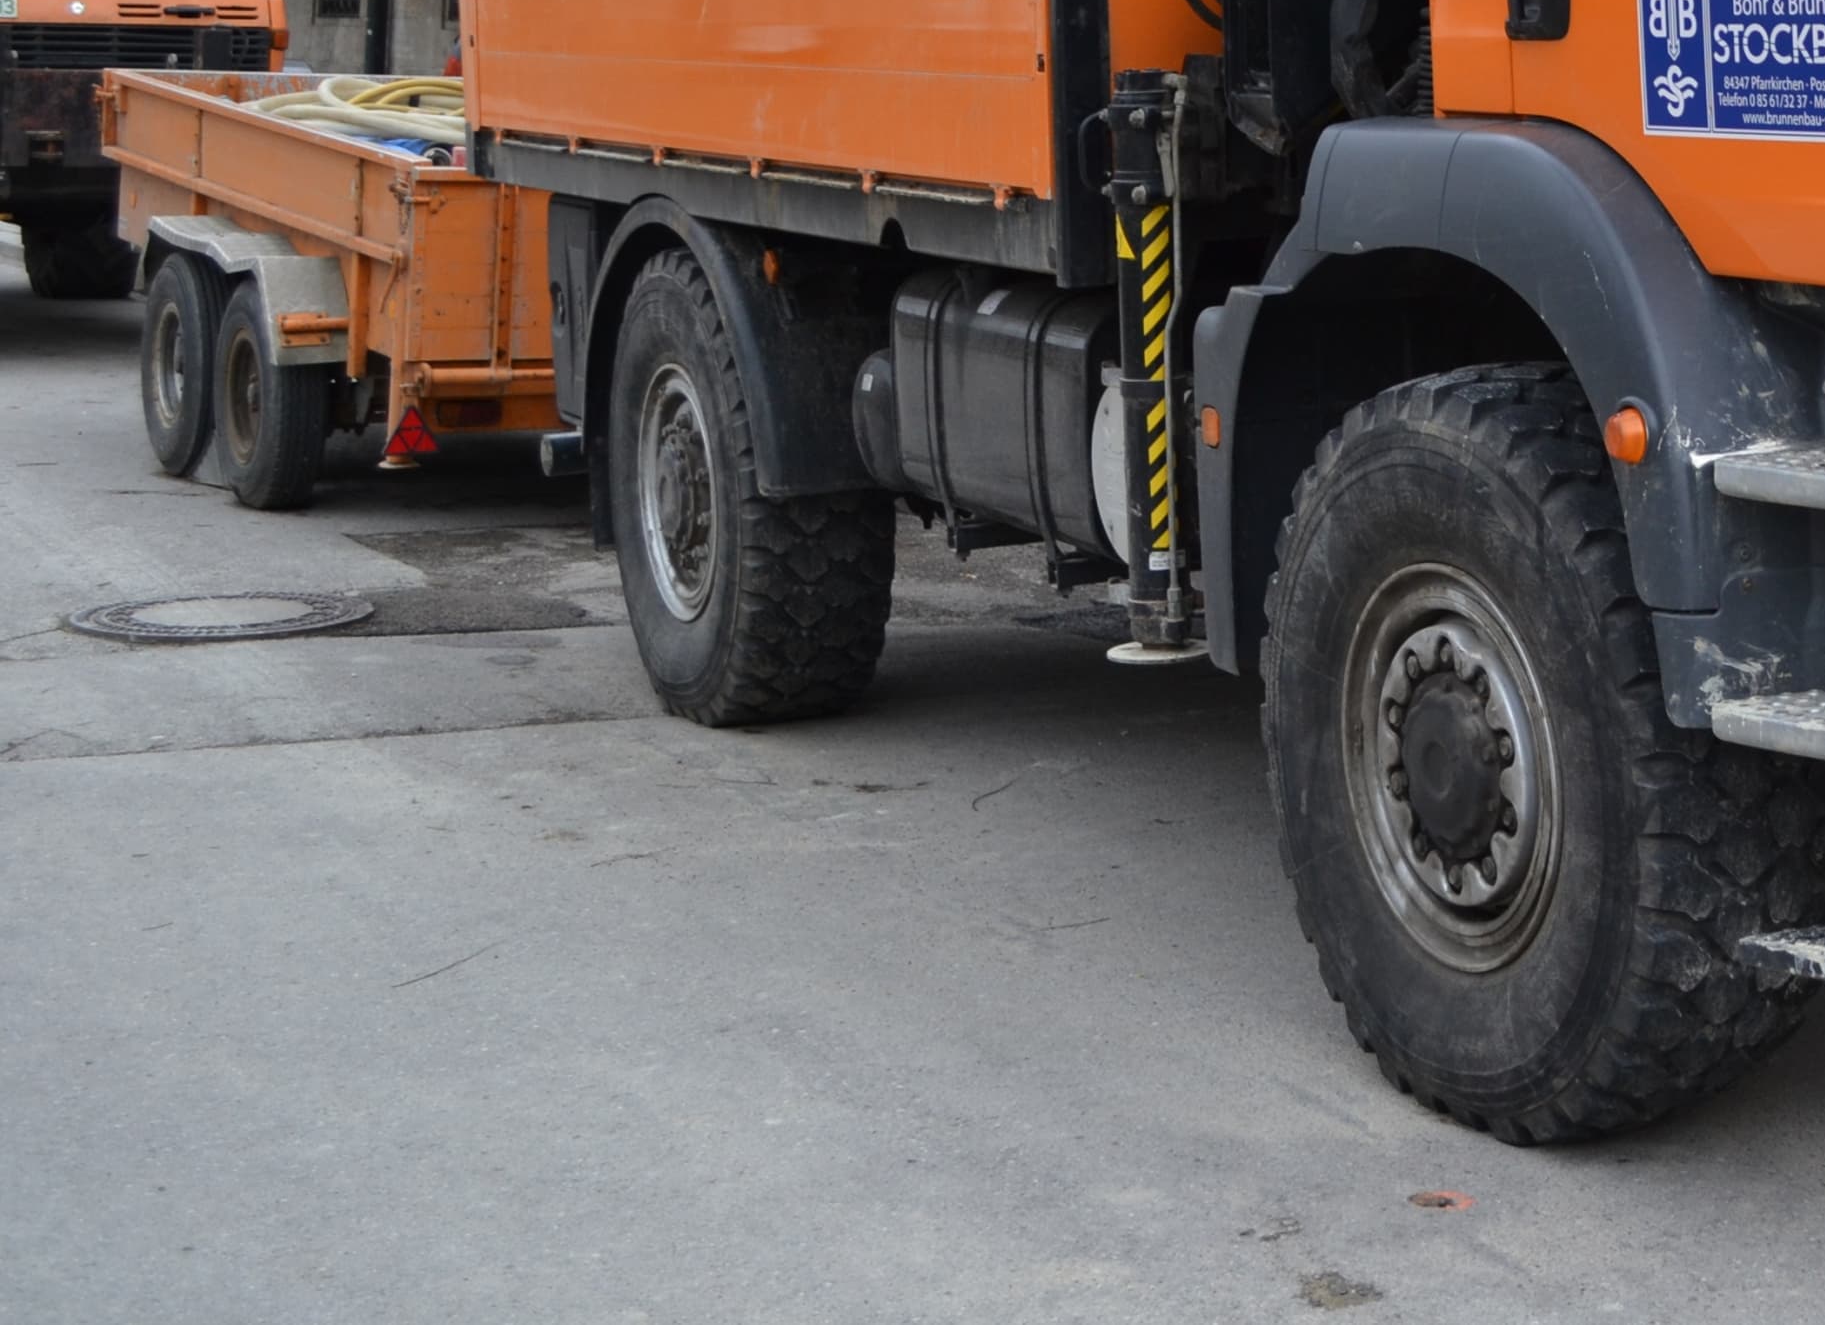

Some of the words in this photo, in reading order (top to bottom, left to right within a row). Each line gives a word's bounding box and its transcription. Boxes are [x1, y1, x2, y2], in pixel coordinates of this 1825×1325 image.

[1723, 76, 1749, 90] 84347
[1751, 76, 1804, 92] Pfarrkirchen
[1717, 92, 1748, 107] Telefon
